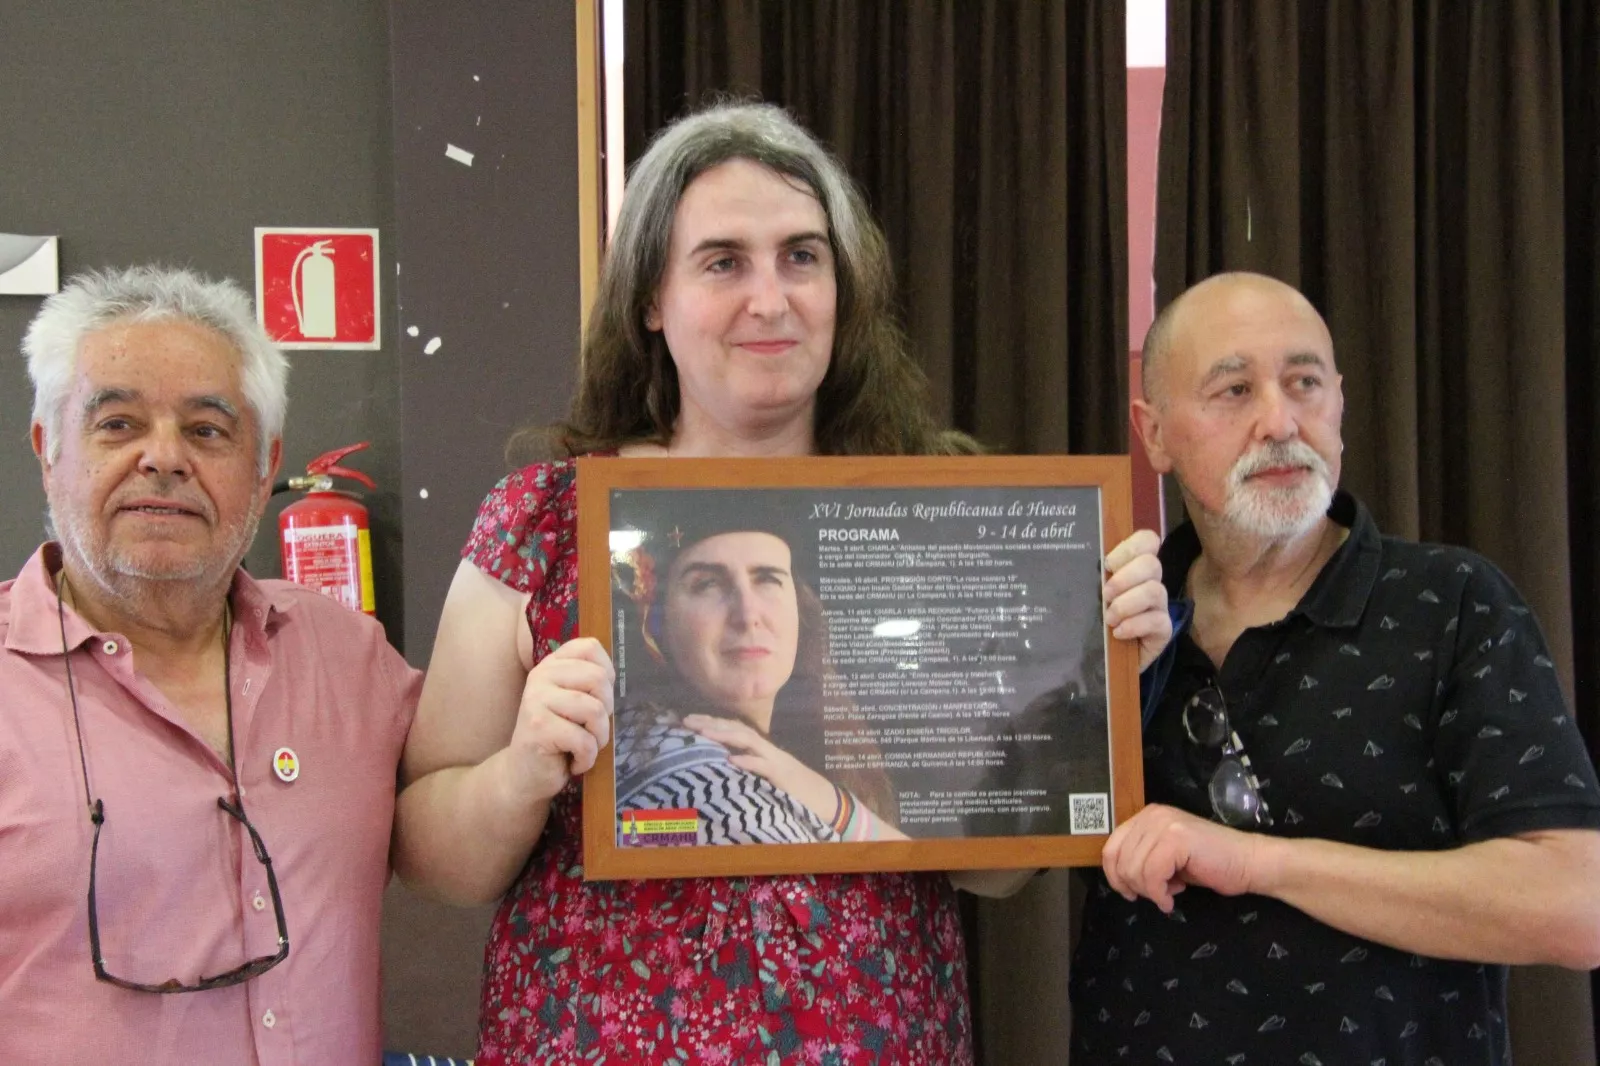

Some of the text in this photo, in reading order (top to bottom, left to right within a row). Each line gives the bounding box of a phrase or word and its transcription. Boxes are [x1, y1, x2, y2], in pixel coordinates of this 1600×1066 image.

[808, 500, 1077, 522] XVI Jornadas Republicanas de Huesca
[819, 528, 900, 541] PROGRAMA
[978, 521, 1076, 539] 9 14 de abril
